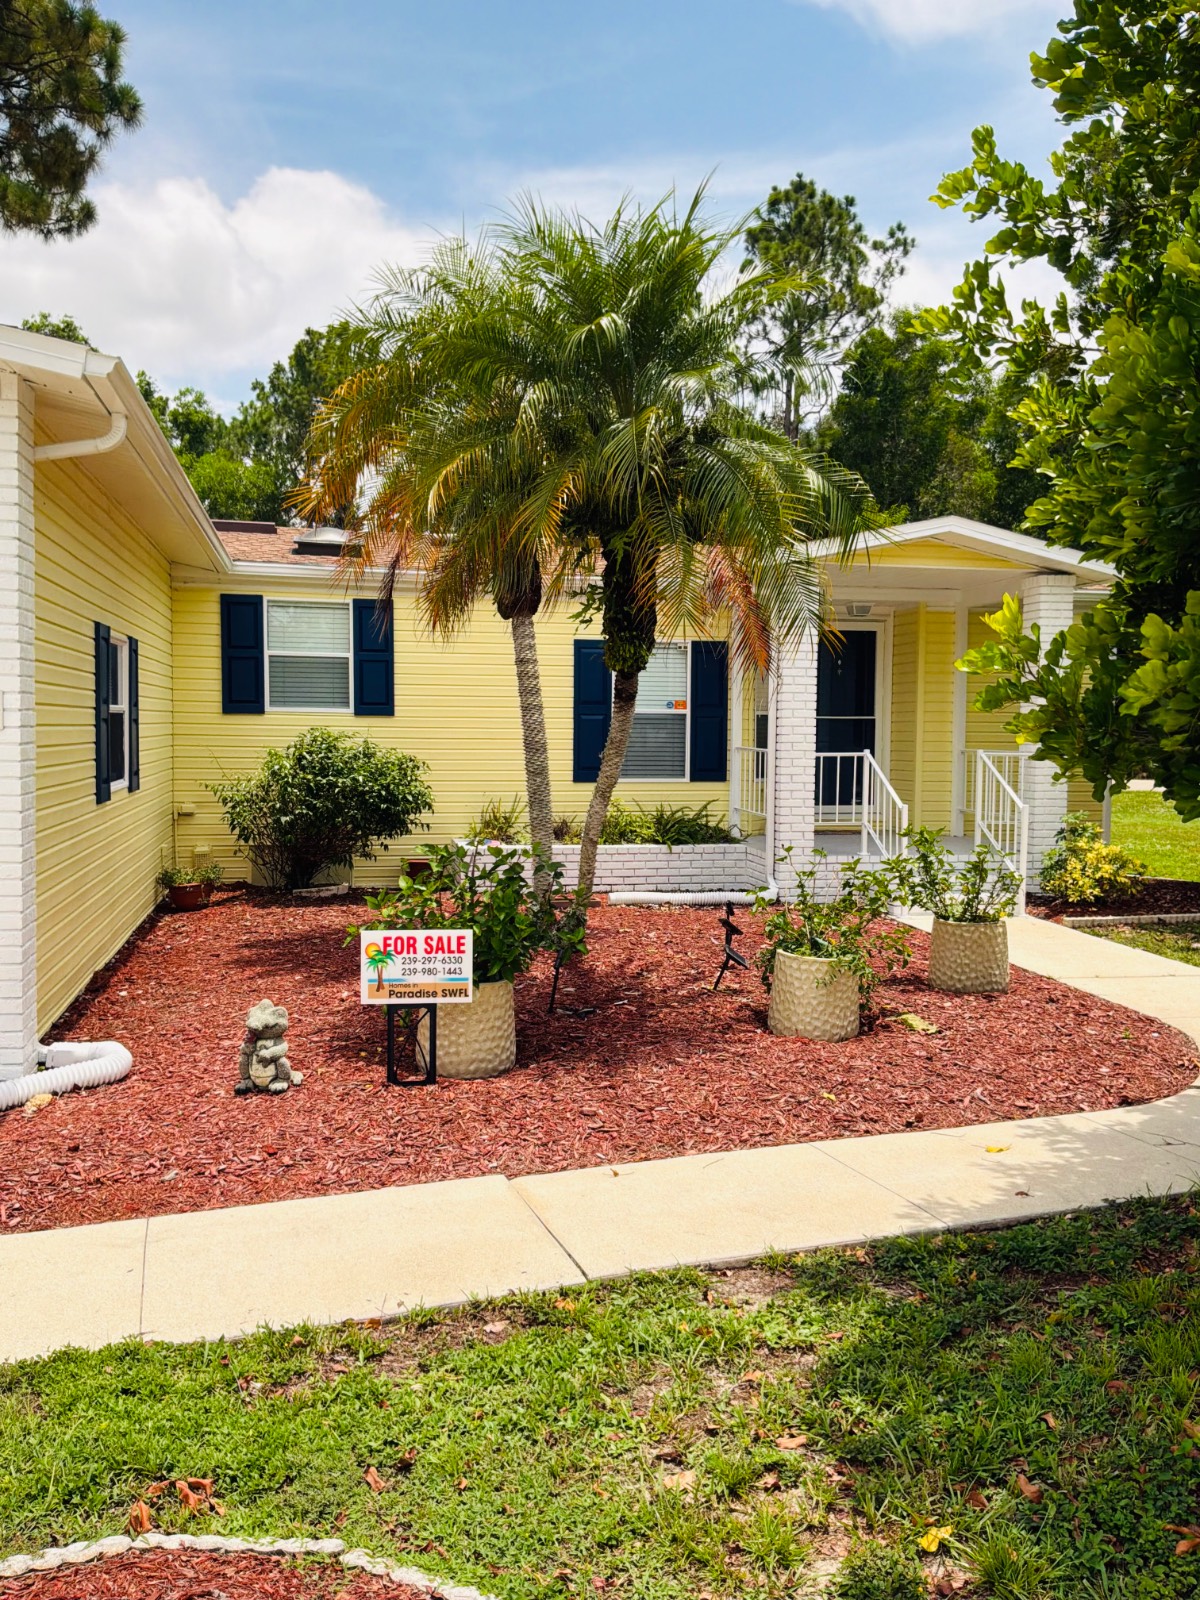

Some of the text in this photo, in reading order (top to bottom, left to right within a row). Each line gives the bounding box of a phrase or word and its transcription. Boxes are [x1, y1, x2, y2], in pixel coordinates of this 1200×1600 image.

[383, 936, 466, 955] FOR SALE
[401, 956, 462, 965] 239-297-6330
[401, 967, 462, 976] 239-980-1443
[388, 988, 469, 998] Paradise SWFL
